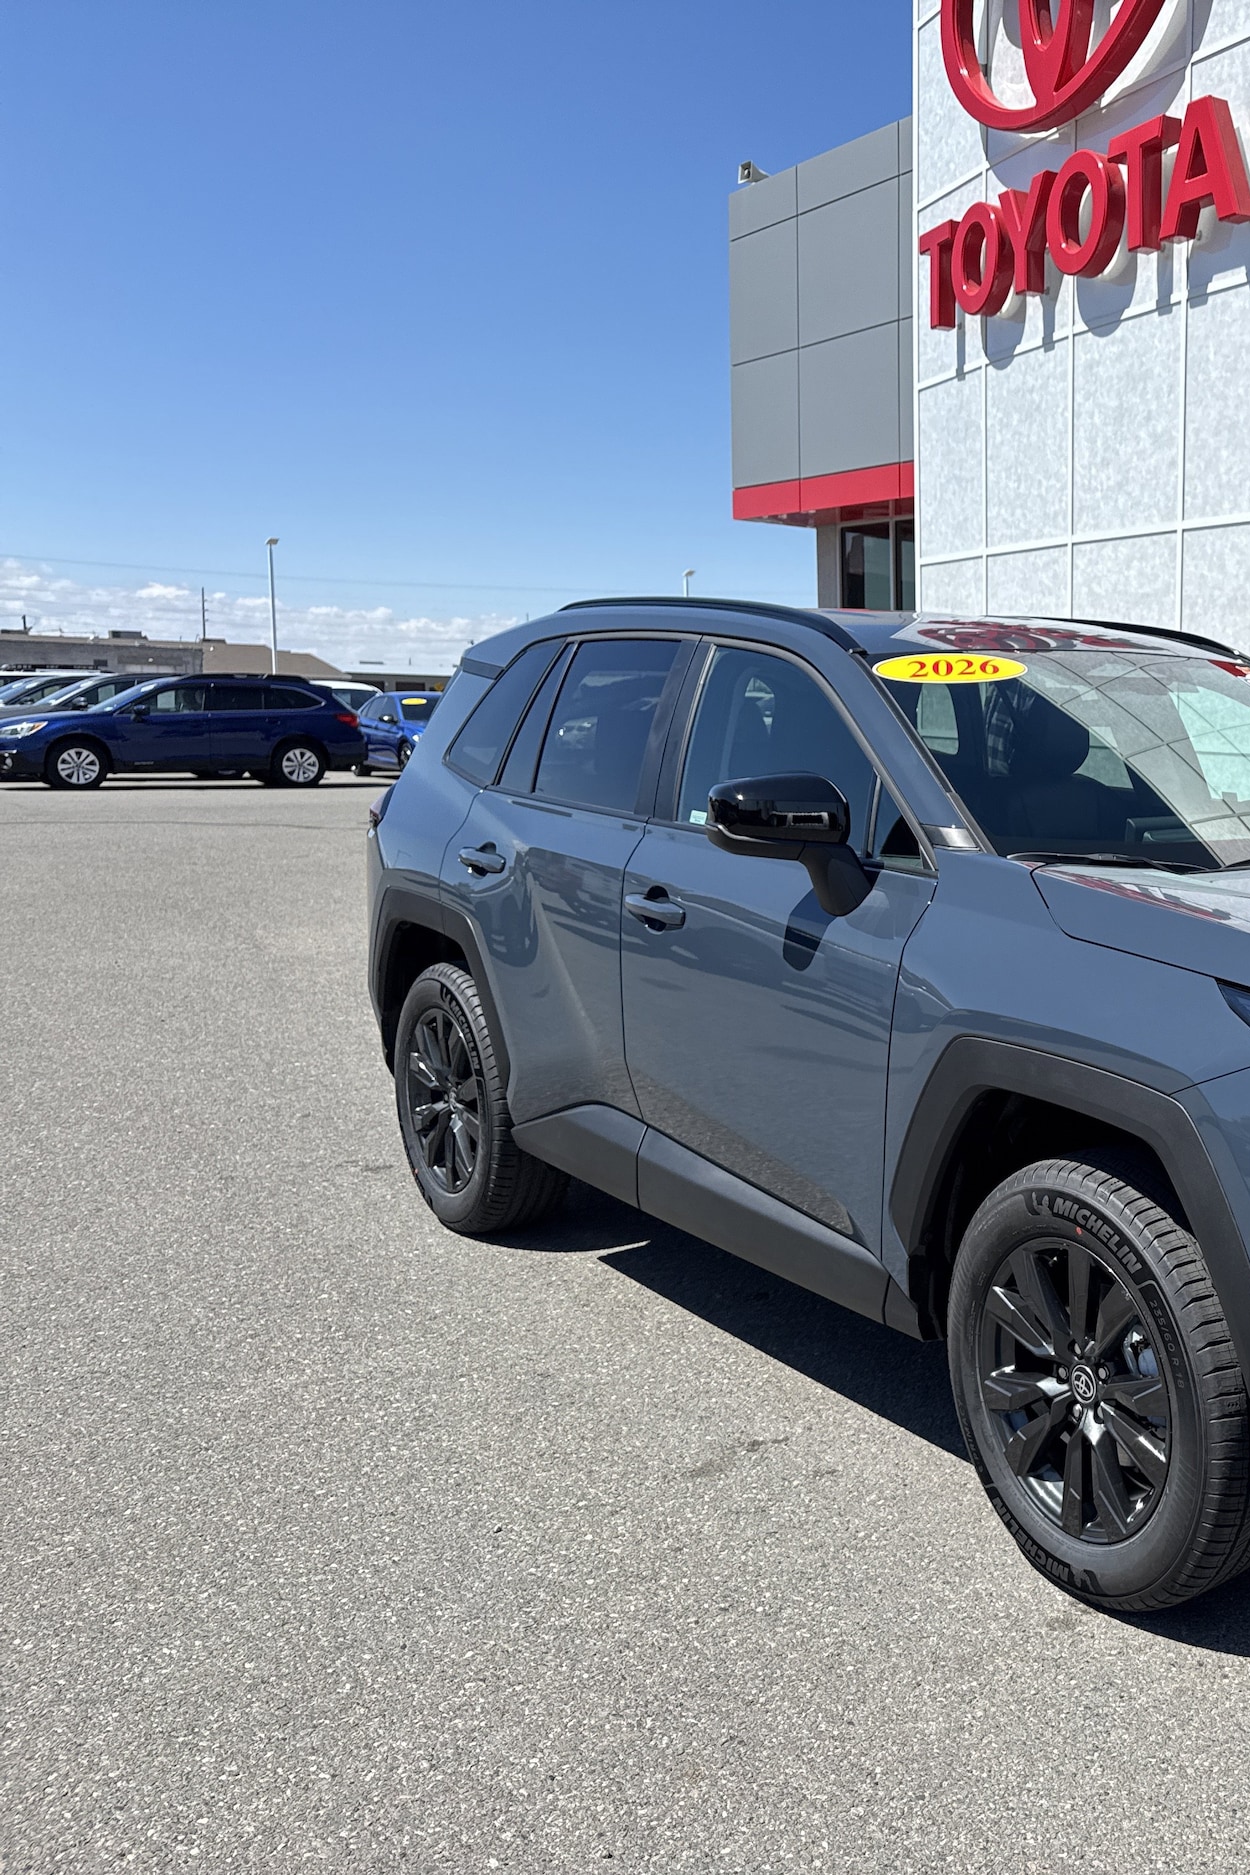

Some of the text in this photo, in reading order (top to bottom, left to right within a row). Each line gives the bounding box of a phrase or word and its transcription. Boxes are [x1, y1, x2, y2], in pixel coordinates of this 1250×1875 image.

[907, 659, 1000, 678] 2026
[451, 1000, 480, 1070] MICHELIN
[1053, 1197, 1142, 1274] MICHELIN
[1150, 1301, 1175, 1352] 235/60
[992, 1496, 1069, 1582] MICHELIN
